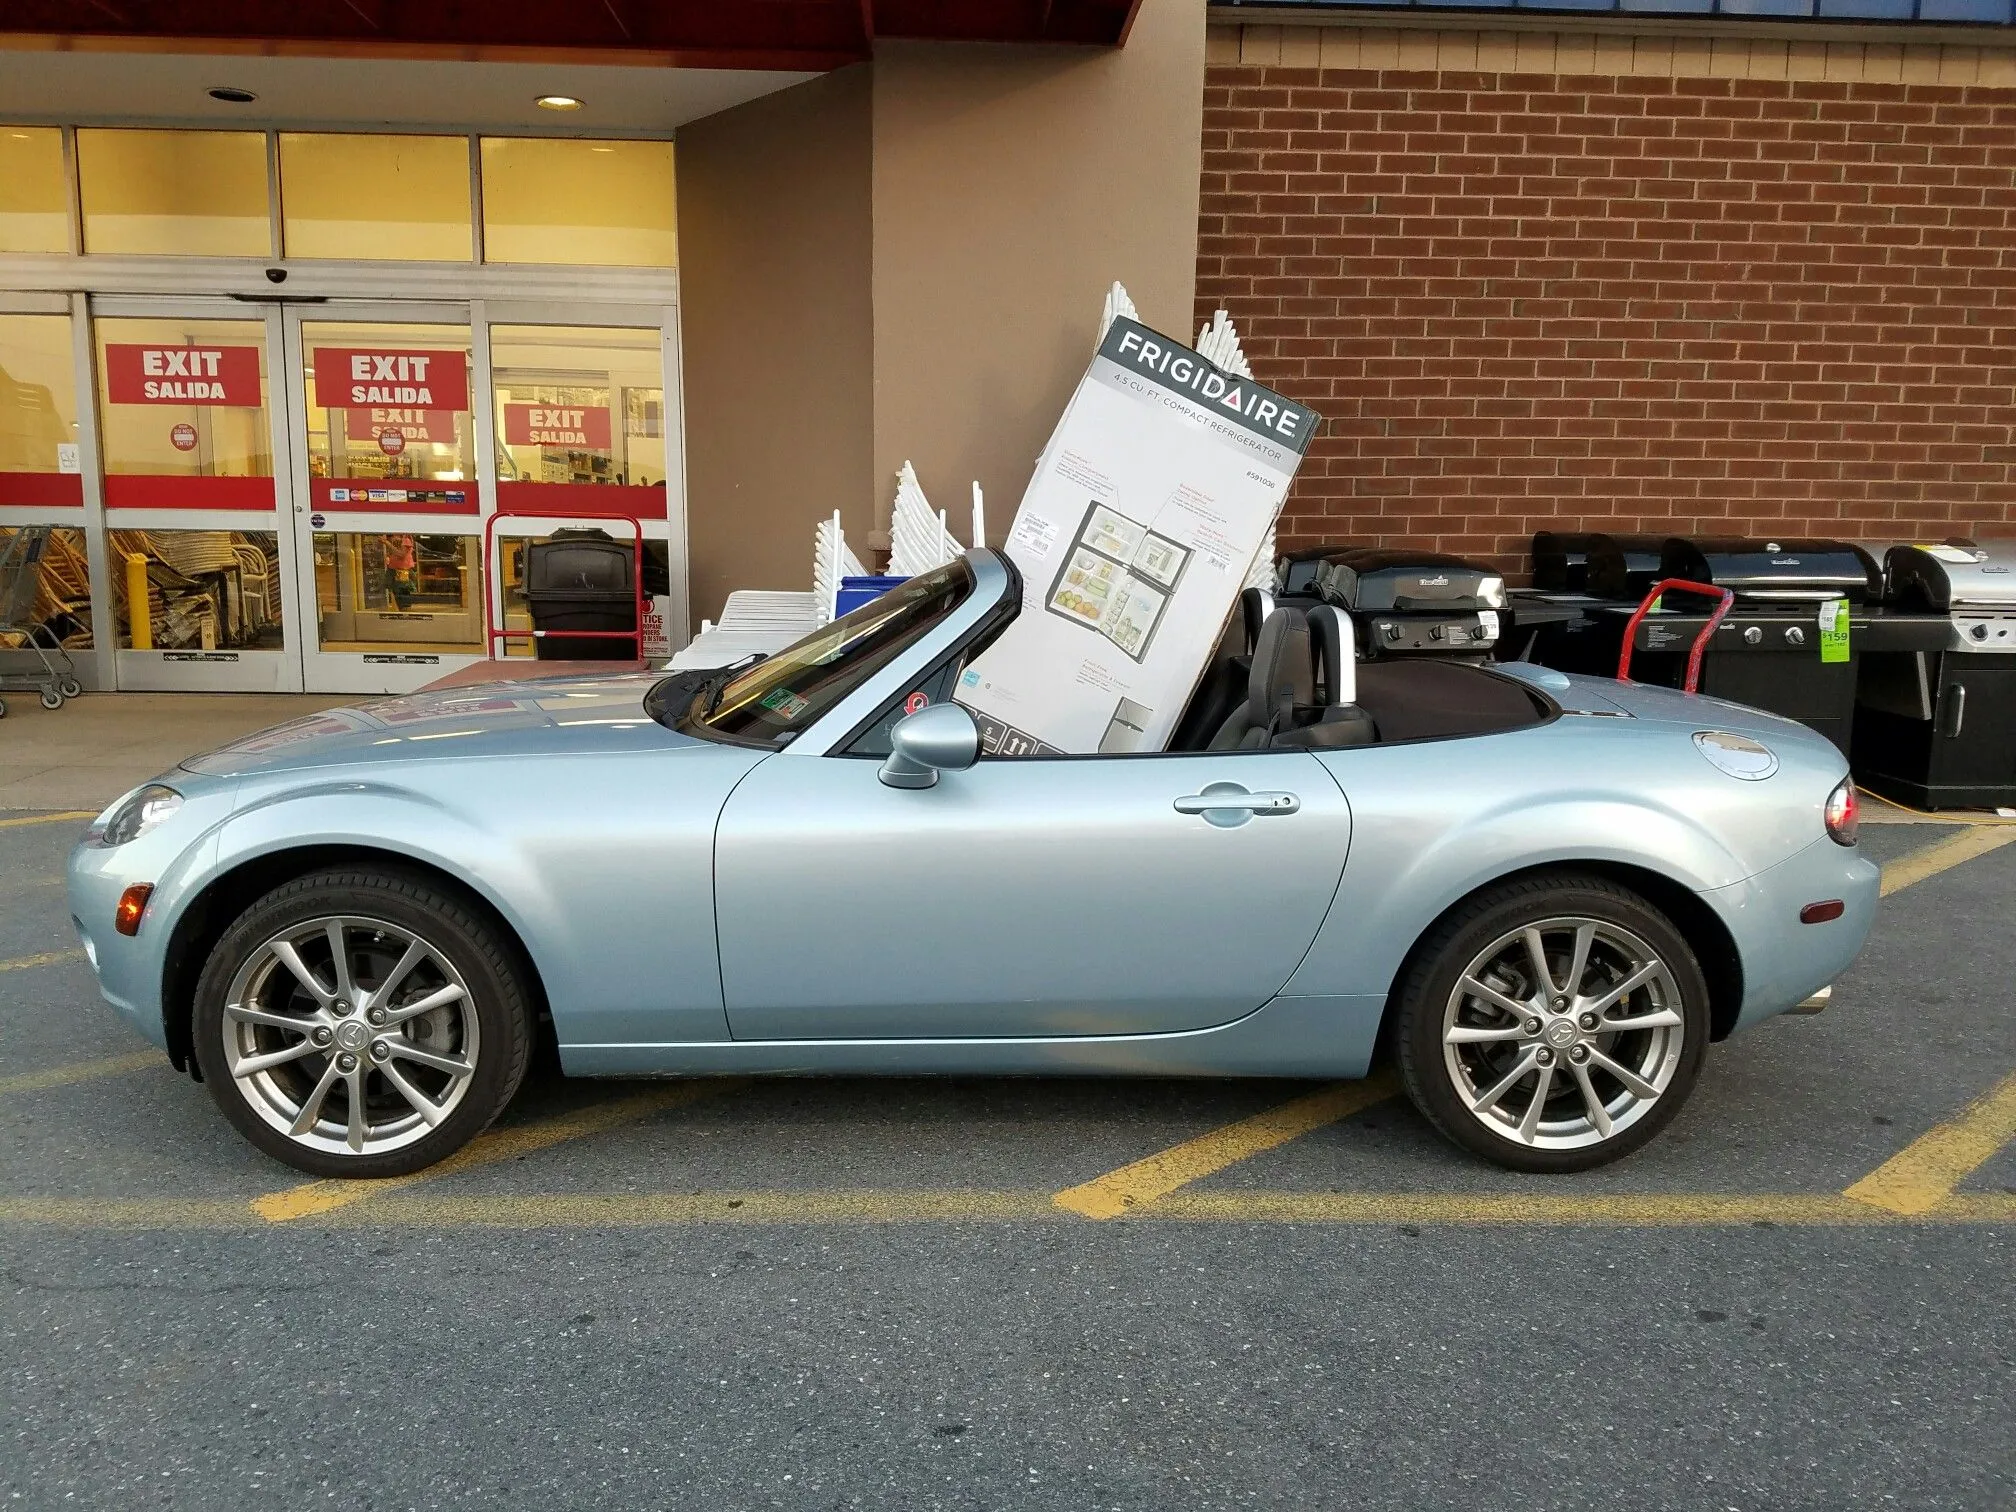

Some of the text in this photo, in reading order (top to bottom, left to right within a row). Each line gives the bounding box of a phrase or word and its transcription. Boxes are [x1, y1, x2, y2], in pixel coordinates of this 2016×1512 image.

[142, 350, 222, 376] EXIT
[351, 355, 430, 381] EXIT
[144, 381, 226, 399] SALIDA
[1118, 331, 1300, 438] FRIGIDAIRE
[351, 385, 433, 404] SALIDA
[371, 408, 425, 423] EXIT
[529, 409, 585, 428] EXIT
[1114, 373, 1129, 385] 4.5
[1163, 397, 1210, 425] COMPACT
[1209, 421, 1282, 461] REFRIGERATOR
[371, 425, 429, 440] SIDA
[529, 430, 587, 444] SALIDA
[643, 615, 663, 624] TICE
[1822, 632, 1848, 642] $159
[985, 726, 994, 735] 5
